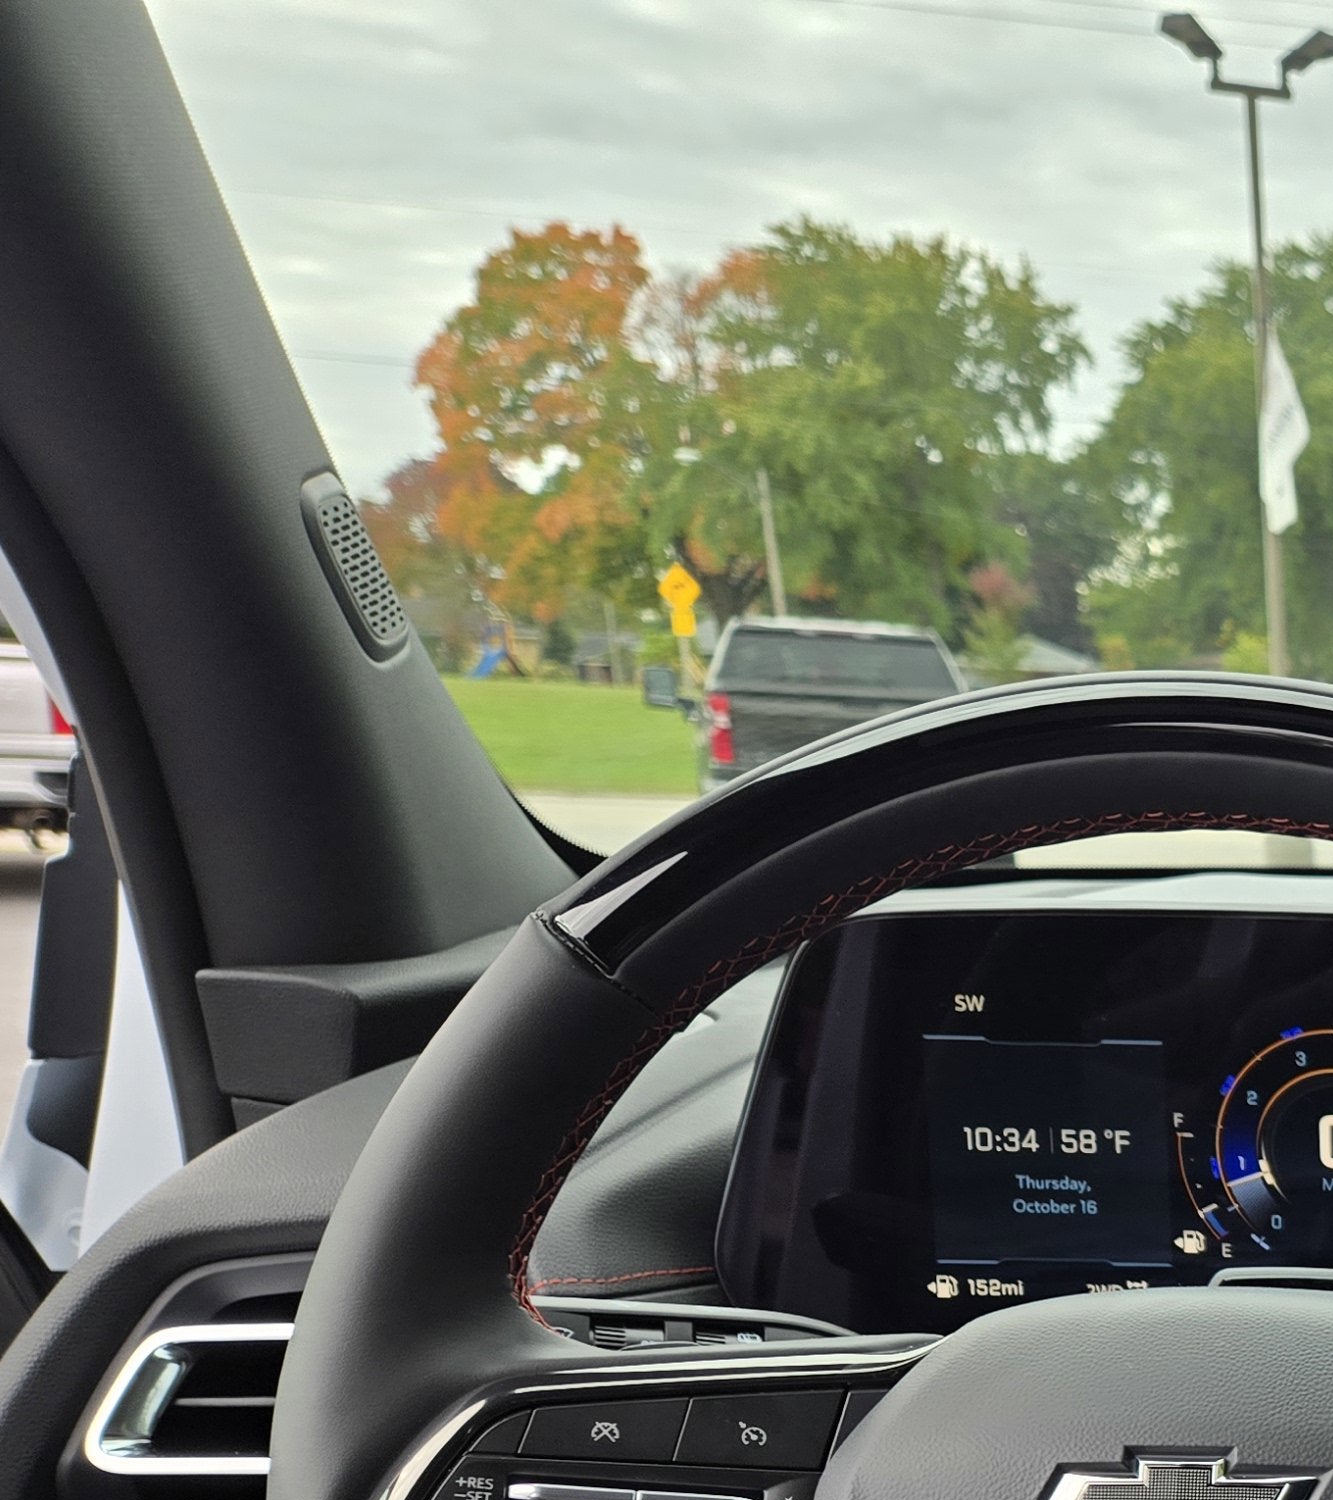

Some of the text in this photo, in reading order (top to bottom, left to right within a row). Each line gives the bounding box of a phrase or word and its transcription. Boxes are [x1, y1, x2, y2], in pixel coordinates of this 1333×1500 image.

[954, 994, 985, 1012] SW
[1295, 1050, 1307, 1067] 3
[1246, 1090, 1258, 1106] 2
[1173, 1112, 1184, 1128] F
[963, 1126, 1040, 1153] 10:34
[1237, 1155, 1247, 1172] 1
[1015, 1174, 1092, 1194] Thursday,
[1012, 1198, 1098, 1215] October 16
[1270, 1214, 1283, 1230] 0
[1221, 1242, 1233, 1258] E
[967, 1278, 1024, 1297] 152mi
[455, 1476, 494, 1490] +RES
